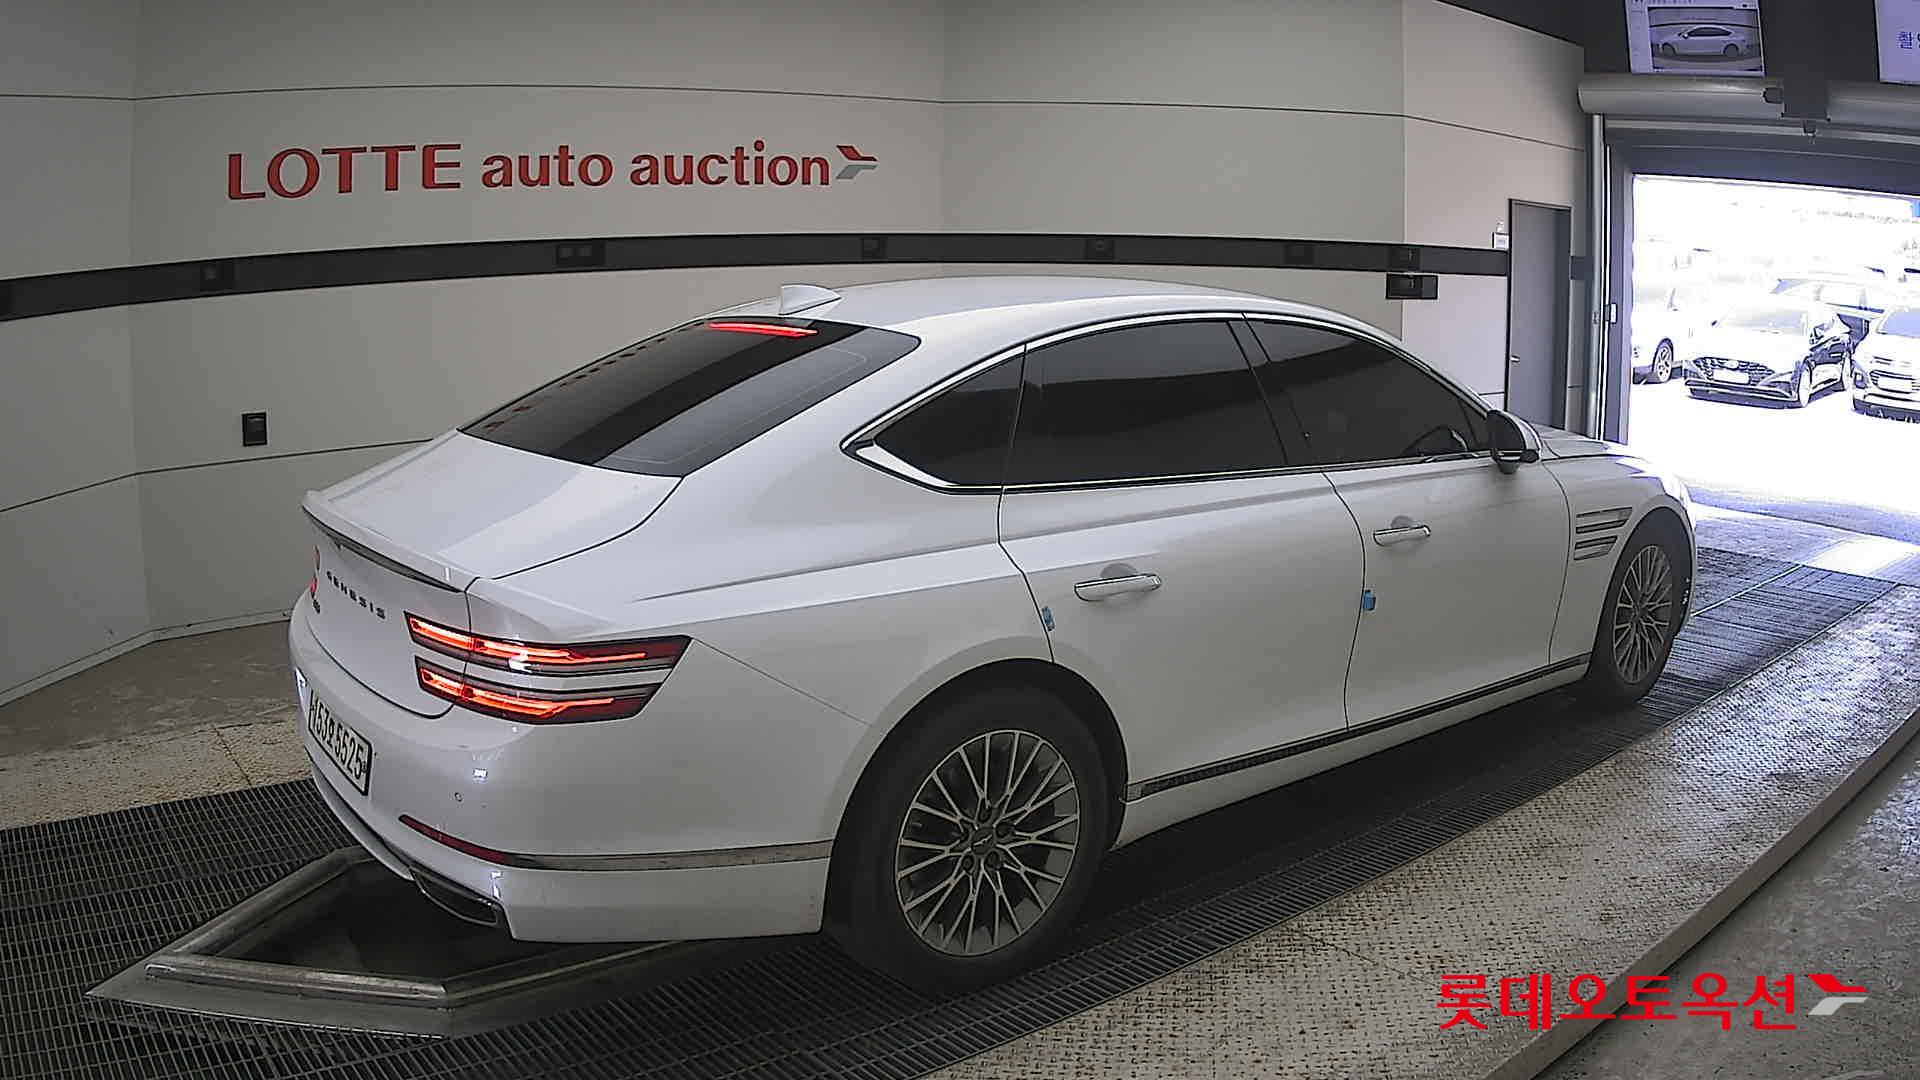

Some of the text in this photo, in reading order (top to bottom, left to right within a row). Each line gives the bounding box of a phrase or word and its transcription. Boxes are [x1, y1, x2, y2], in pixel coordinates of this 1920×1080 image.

[228, 140, 831, 200] LOTTE auto auction
[326, 571, 386, 620] GENESIS
